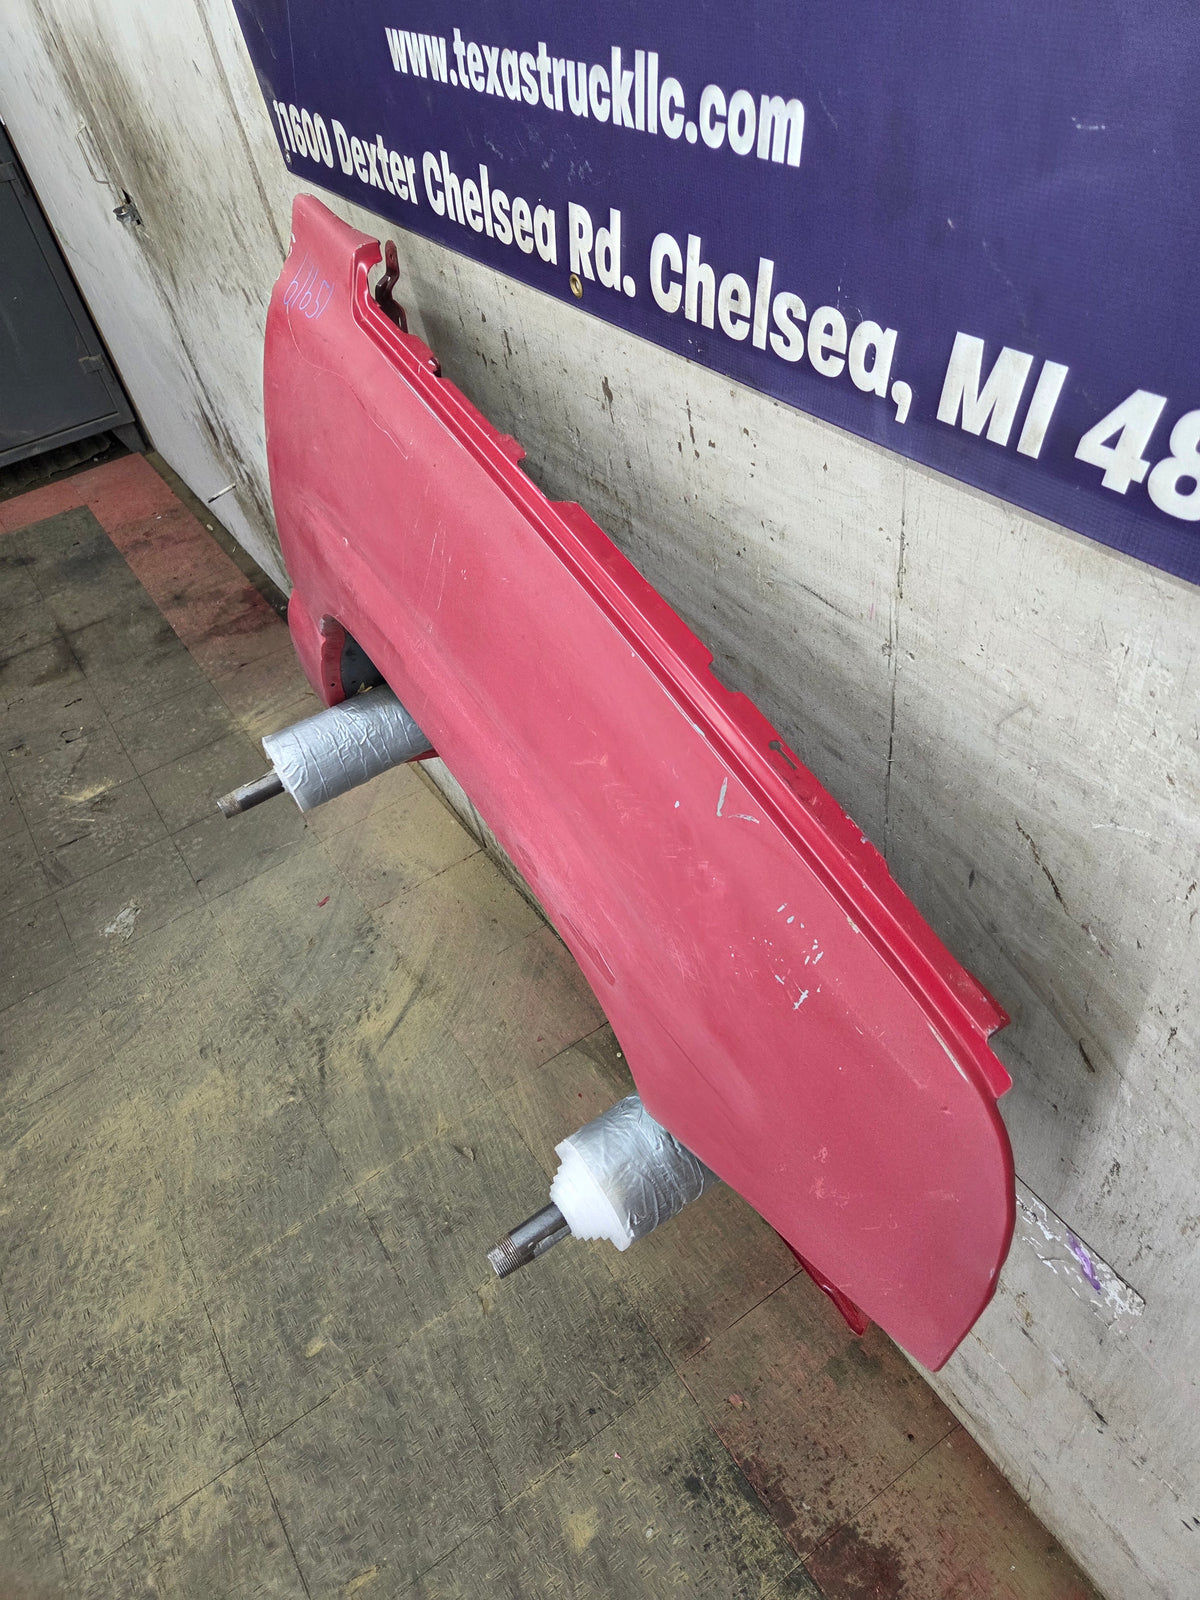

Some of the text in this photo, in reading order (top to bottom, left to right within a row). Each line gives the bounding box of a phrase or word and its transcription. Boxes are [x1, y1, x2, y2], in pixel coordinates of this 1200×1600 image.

[384, 27, 805, 168] www.texastruckllc.com
[273, 100, 334, 169] 11600
[330, 118, 418, 205] Dexter
[422, 151, 558, 266] Chelsea
[568, 201, 636, 298] Rd.
[649, 232, 913, 425] Chelsea,
[936, 330, 1070, 460] MI
